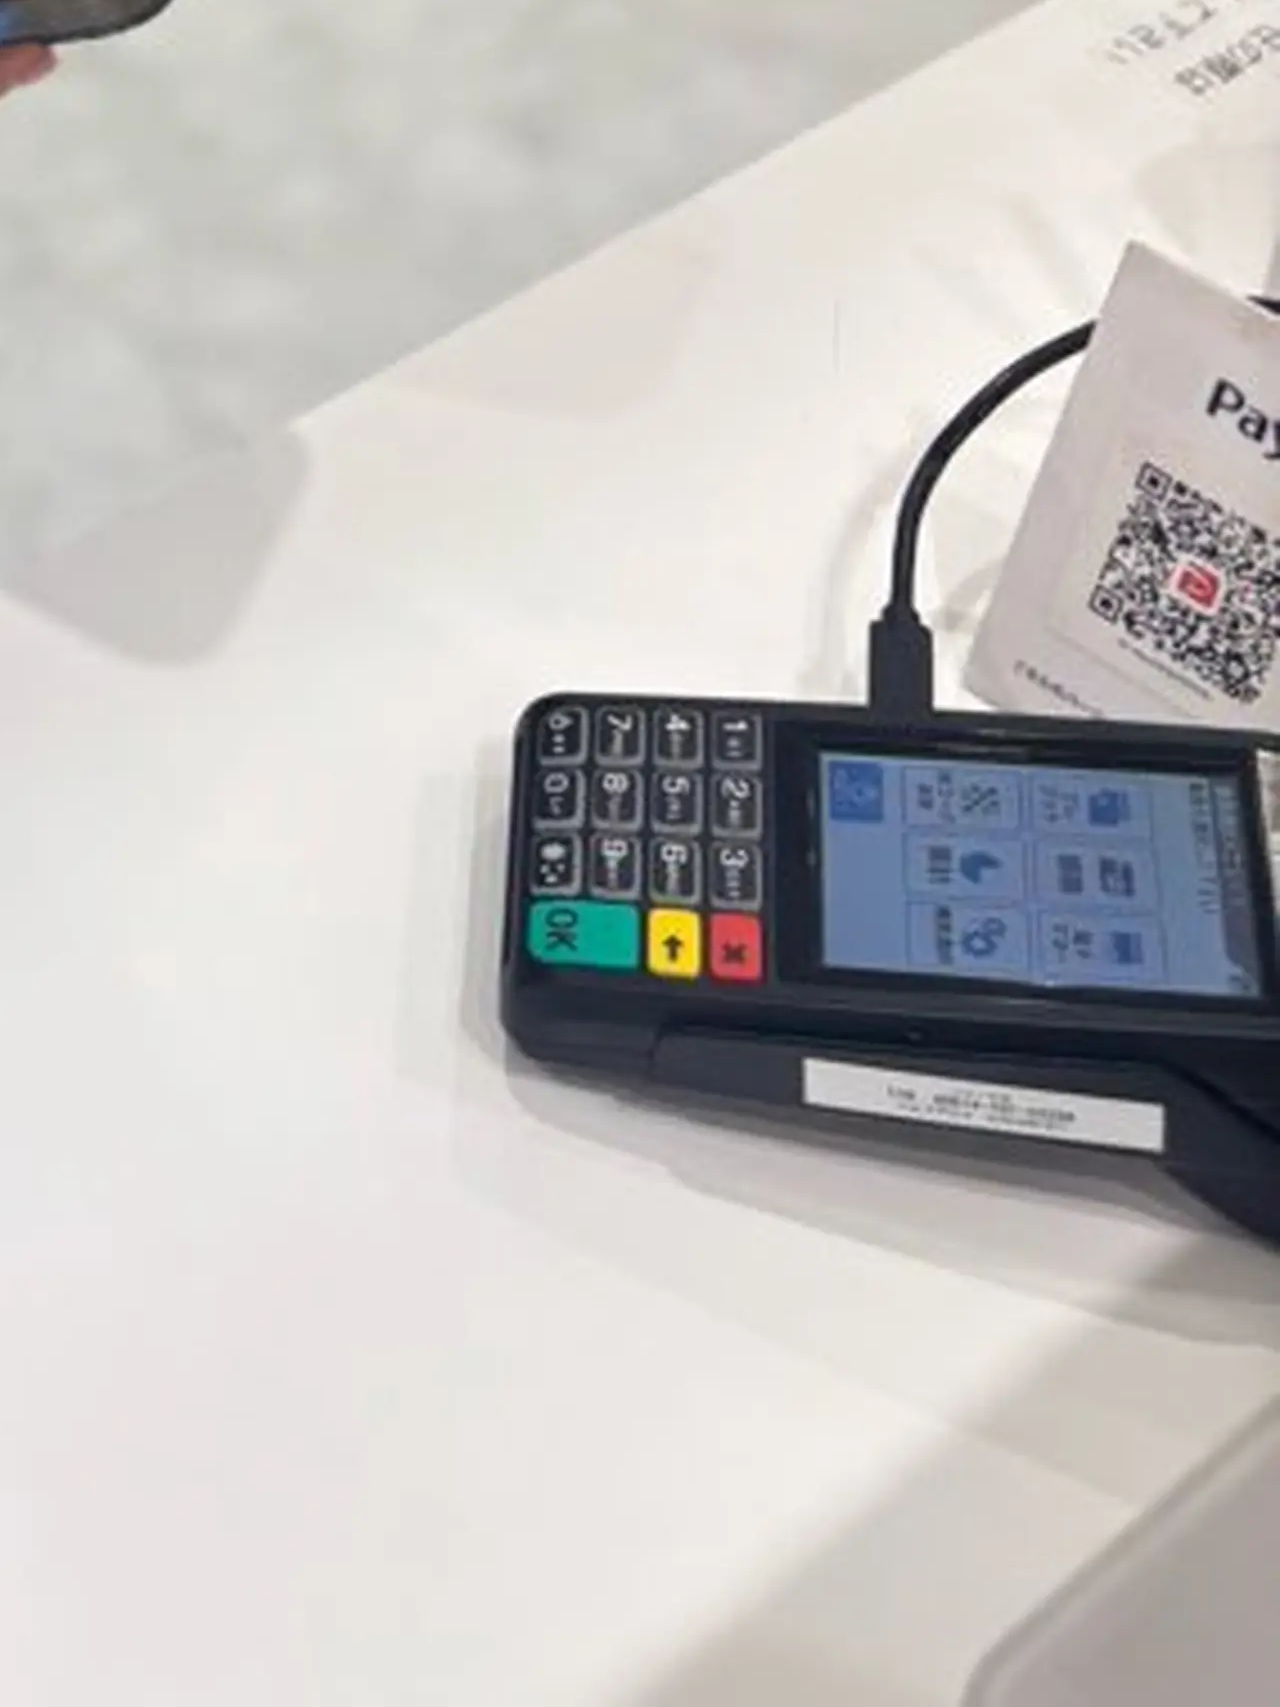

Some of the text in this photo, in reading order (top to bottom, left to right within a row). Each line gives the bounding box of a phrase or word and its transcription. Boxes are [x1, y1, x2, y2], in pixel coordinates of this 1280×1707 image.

[606, 713, 633, 731] 7
[664, 713, 692, 731] 4
[722, 719, 749, 732] 1
[543, 772, 570, 794] 0
[602, 772, 630, 794] 8
[662, 775, 689, 795] 5
[720, 777, 751, 800] 2
[601, 839, 628, 859] 9
[660, 843, 688, 864] 6
[719, 848, 750, 869] 3
[545, 907, 580, 951] OK
